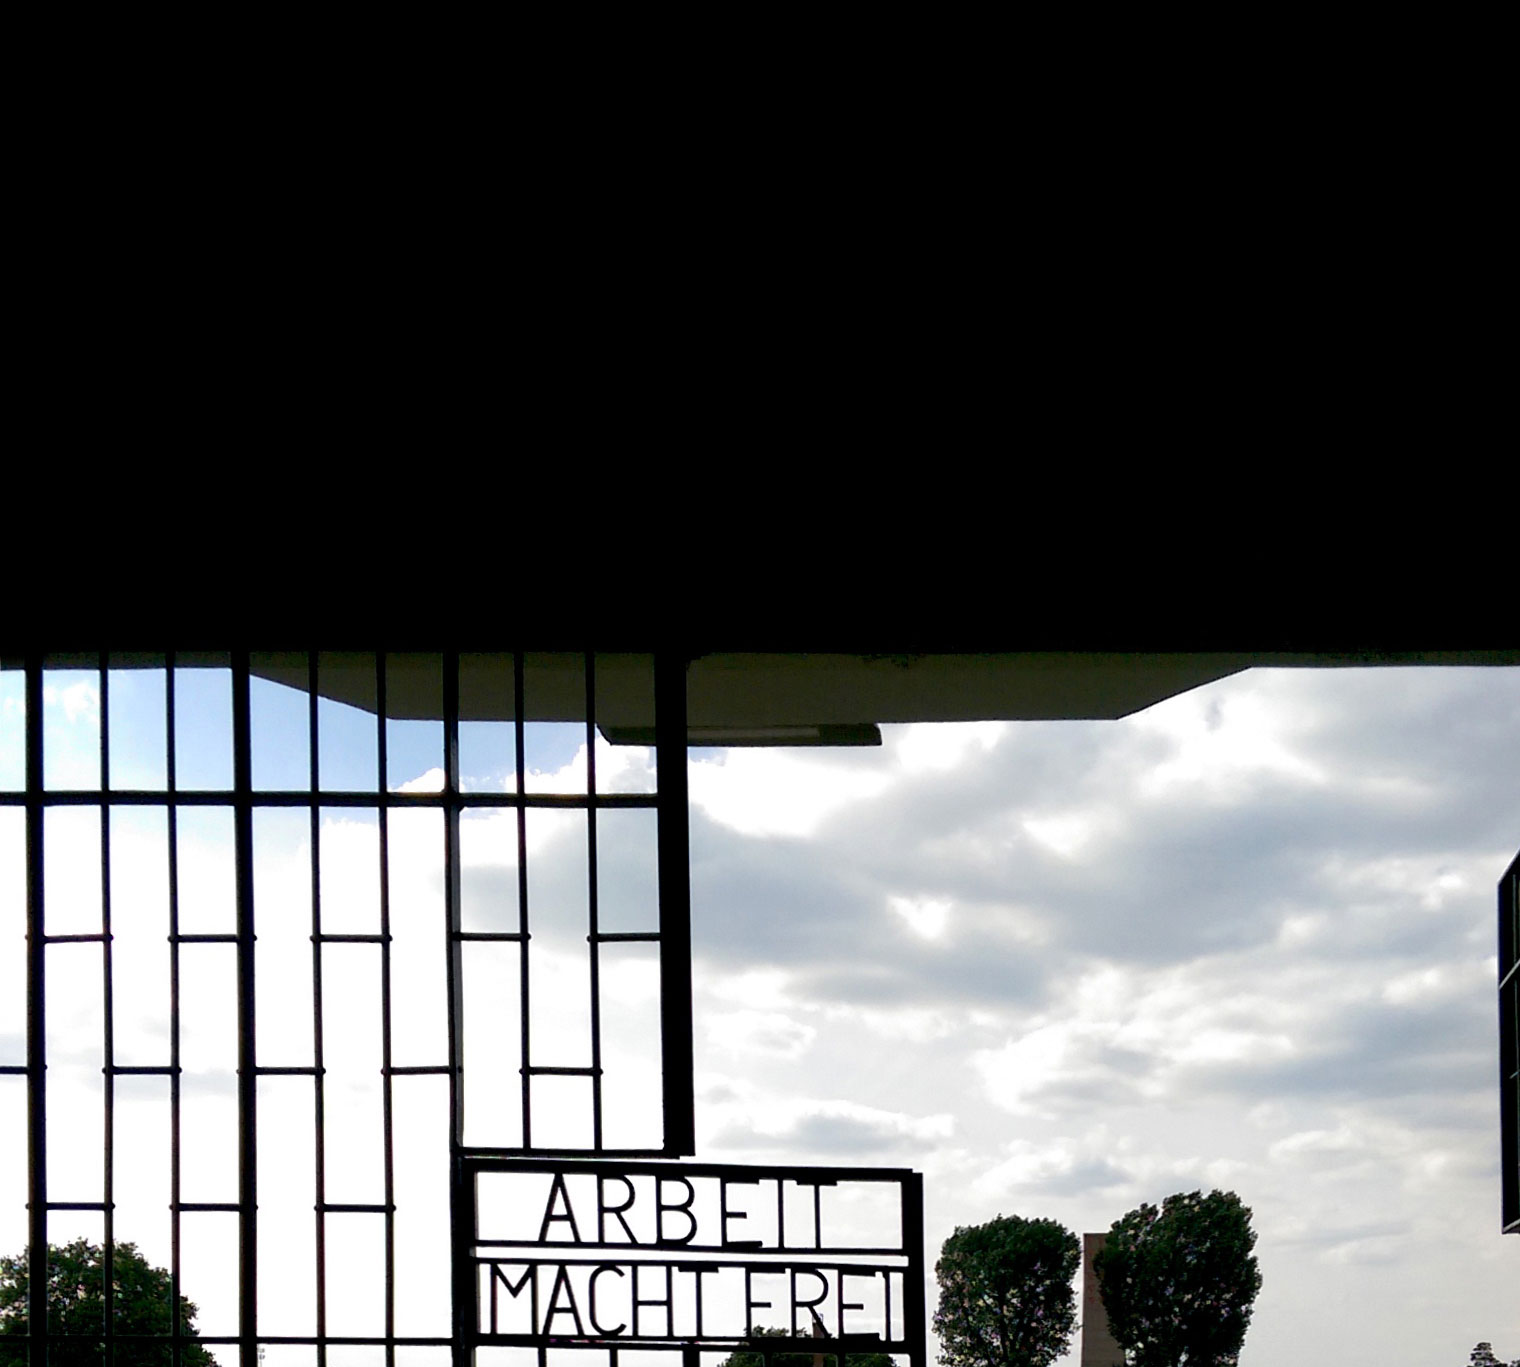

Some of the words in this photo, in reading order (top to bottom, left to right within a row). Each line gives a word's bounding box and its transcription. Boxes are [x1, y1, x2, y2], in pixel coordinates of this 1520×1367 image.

[539, 1172, 838, 1250] ARBEIT
[490, 1262, 719, 1339] MACHT
[745, 1264, 892, 1341] FREI
